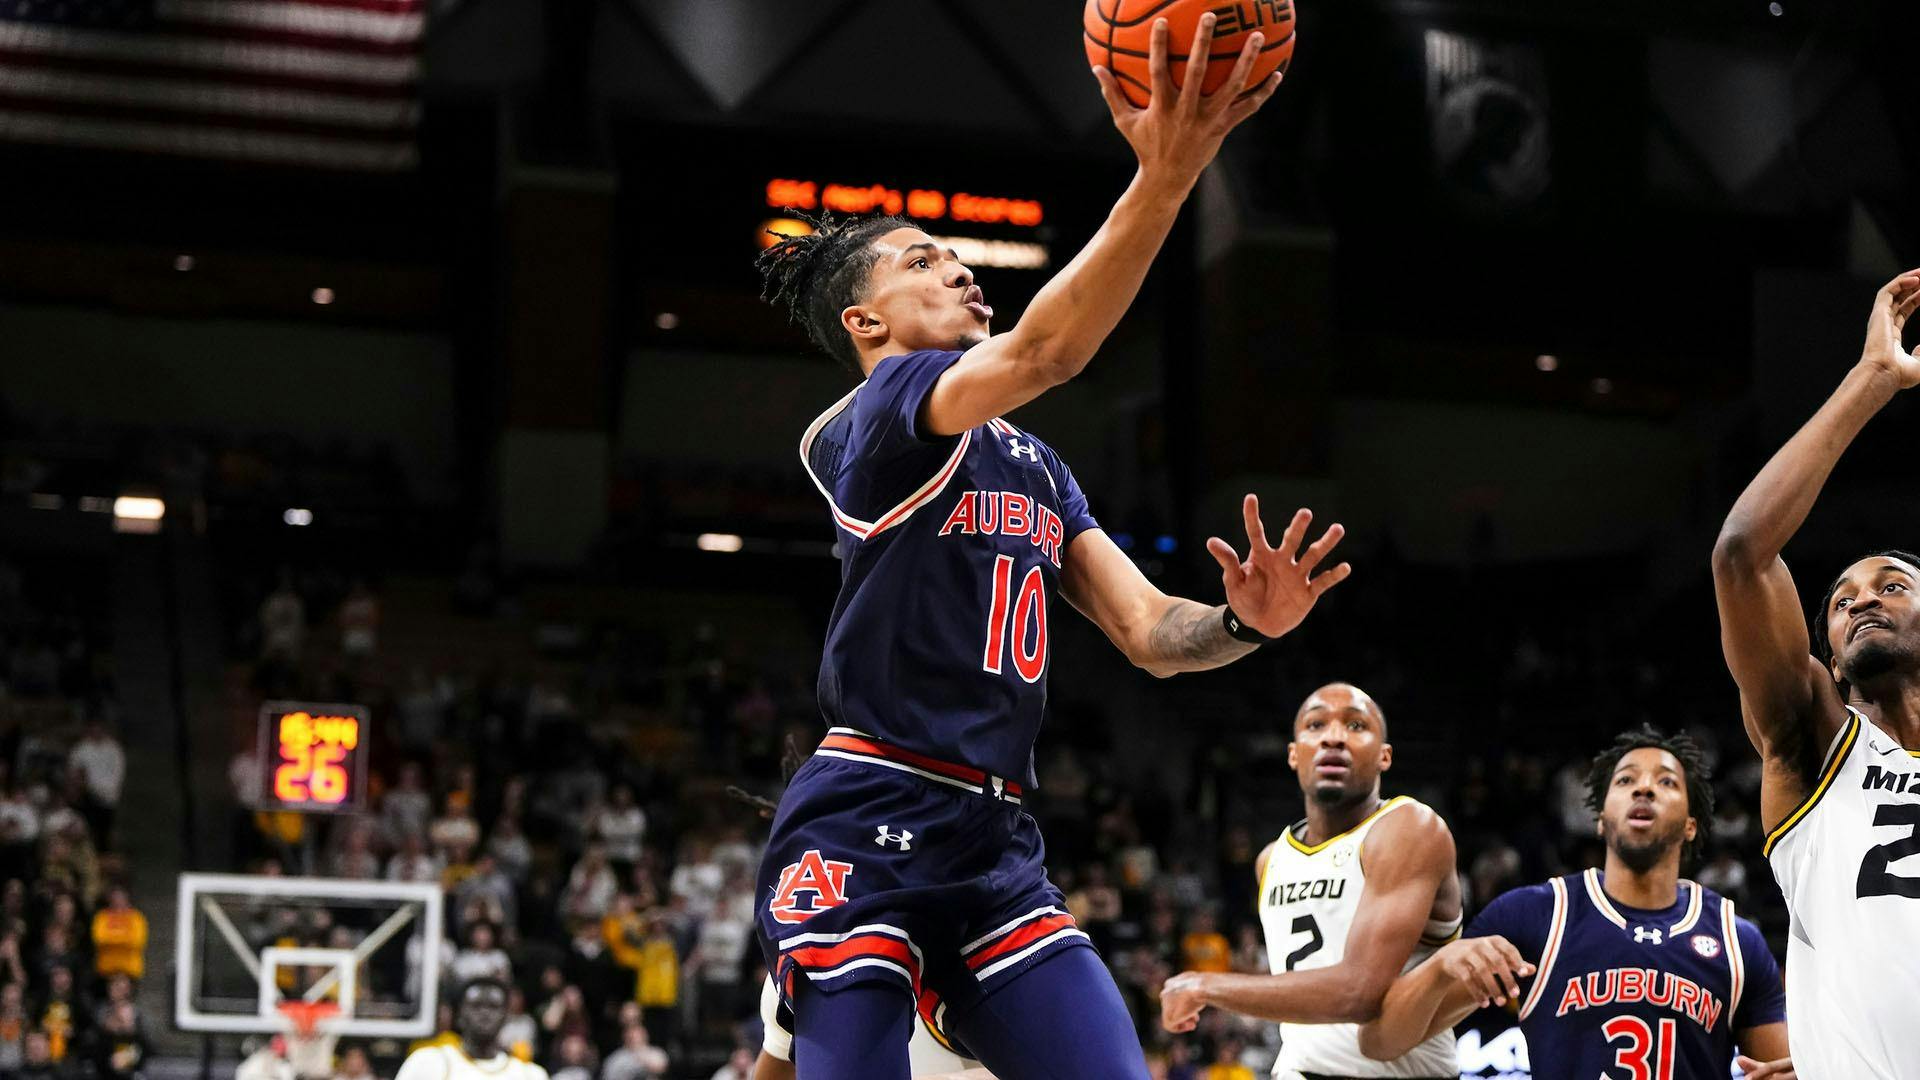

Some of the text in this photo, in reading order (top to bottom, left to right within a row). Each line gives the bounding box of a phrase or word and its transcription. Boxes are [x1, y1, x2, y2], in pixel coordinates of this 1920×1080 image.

[1211, 0, 1291, 38] ELITE
[983, 553, 1047, 684] 10
[274, 743, 348, 802] 26
[1268, 878, 1347, 907] MIZZOU
[1286, 914, 1323, 971] 2
[1555, 967, 1723, 1034] AUBURN
[1599, 1014, 1678, 1080] 31
